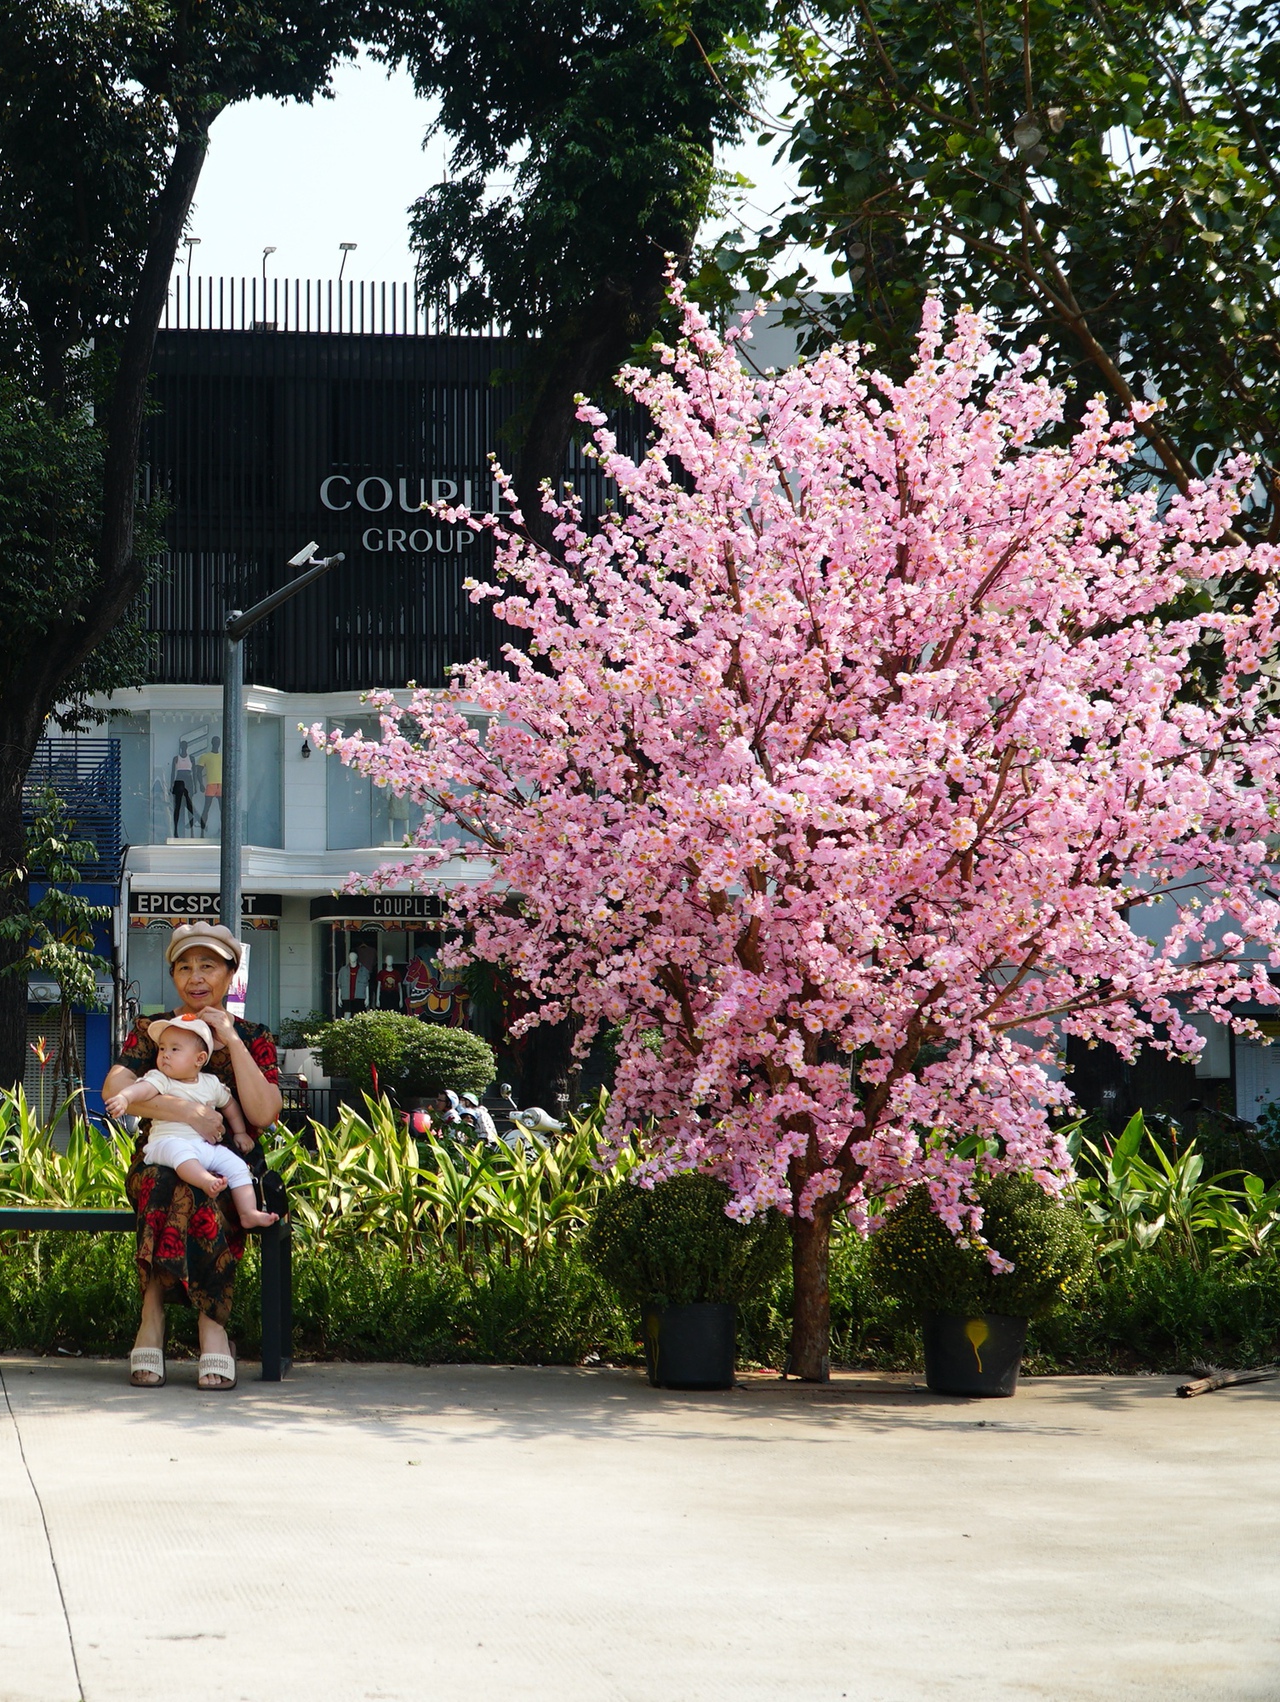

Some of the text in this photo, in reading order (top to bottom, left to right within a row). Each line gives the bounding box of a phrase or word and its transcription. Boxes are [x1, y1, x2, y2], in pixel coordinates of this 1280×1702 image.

[320, 475, 515, 516] COUPLE
[362, 528, 475, 553] GROUP
[373, 898, 431, 915] COUPLE
